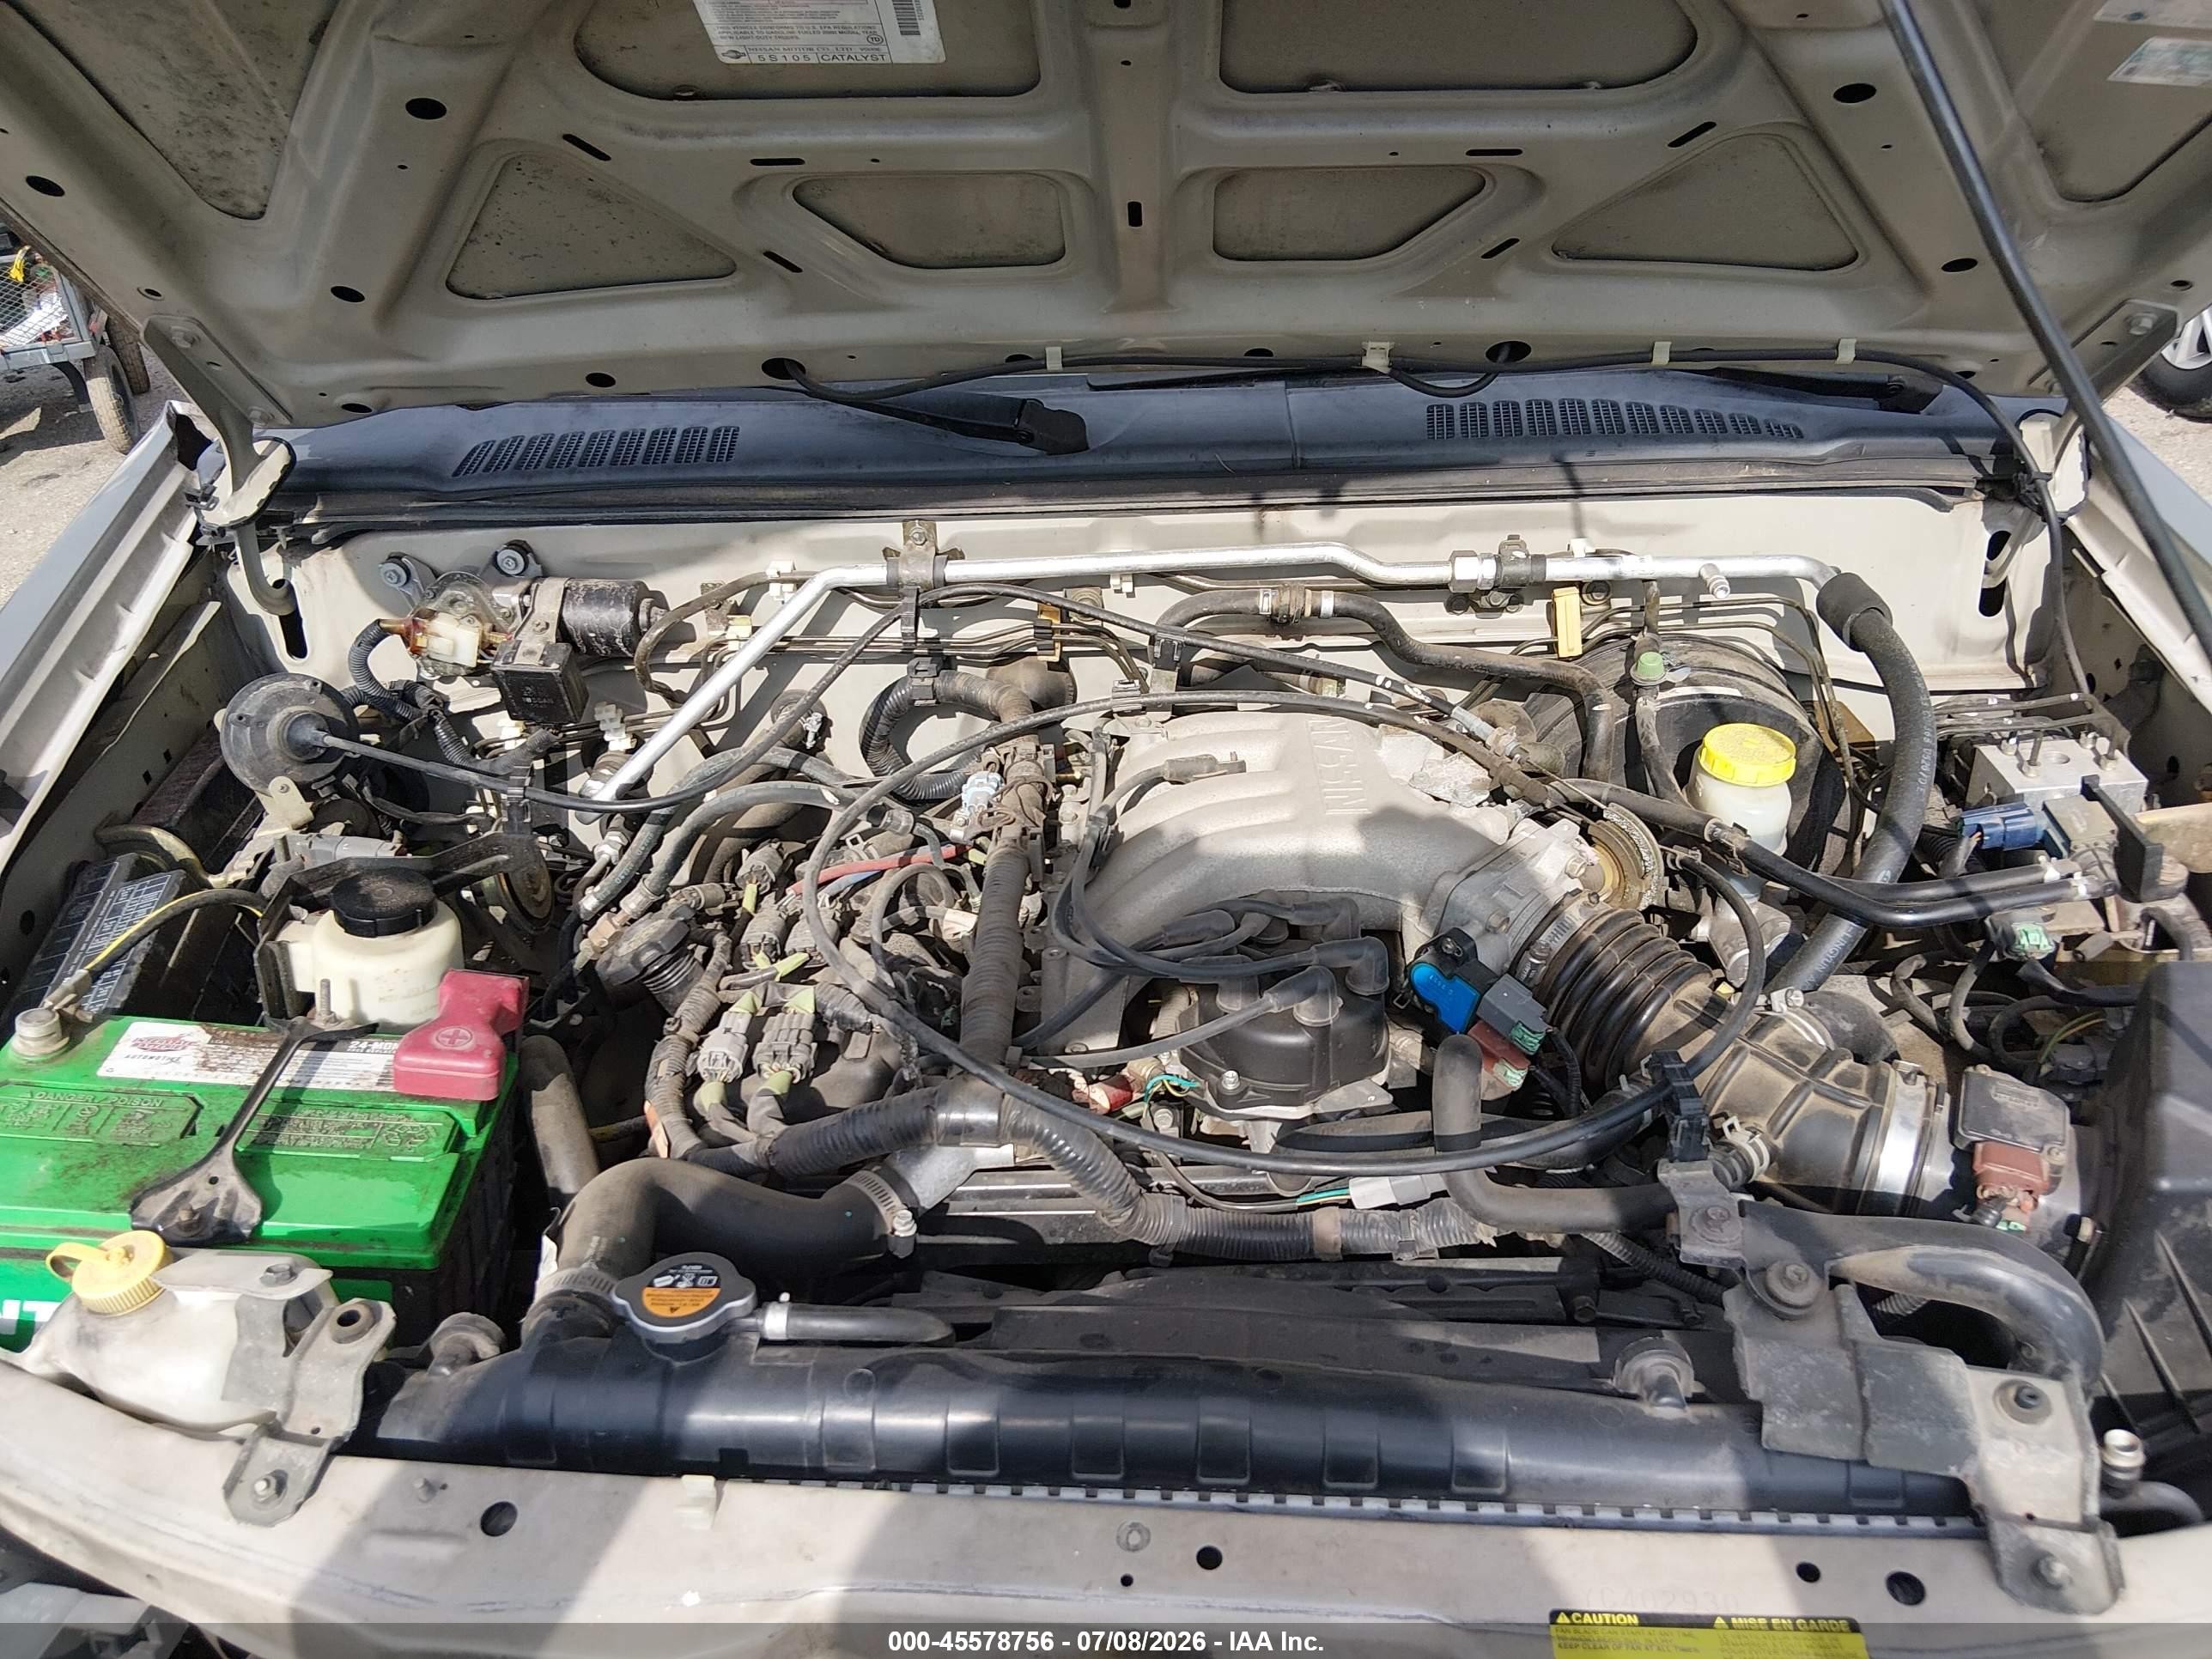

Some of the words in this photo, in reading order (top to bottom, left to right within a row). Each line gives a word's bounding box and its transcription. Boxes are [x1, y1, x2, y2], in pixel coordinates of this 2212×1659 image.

[348, 1040, 399, 1051] 24-MON
[34, 1091, 94, 1103] DANGER
[107, 1096, 163, 1107] POISON
[1571, 1612, 1639, 1626] CAUTION
[1729, 1617, 1769, 1631] MISE
[1771, 1618, 1794, 1632] EN
[1796, 1619, 1852, 1633] GARDE
